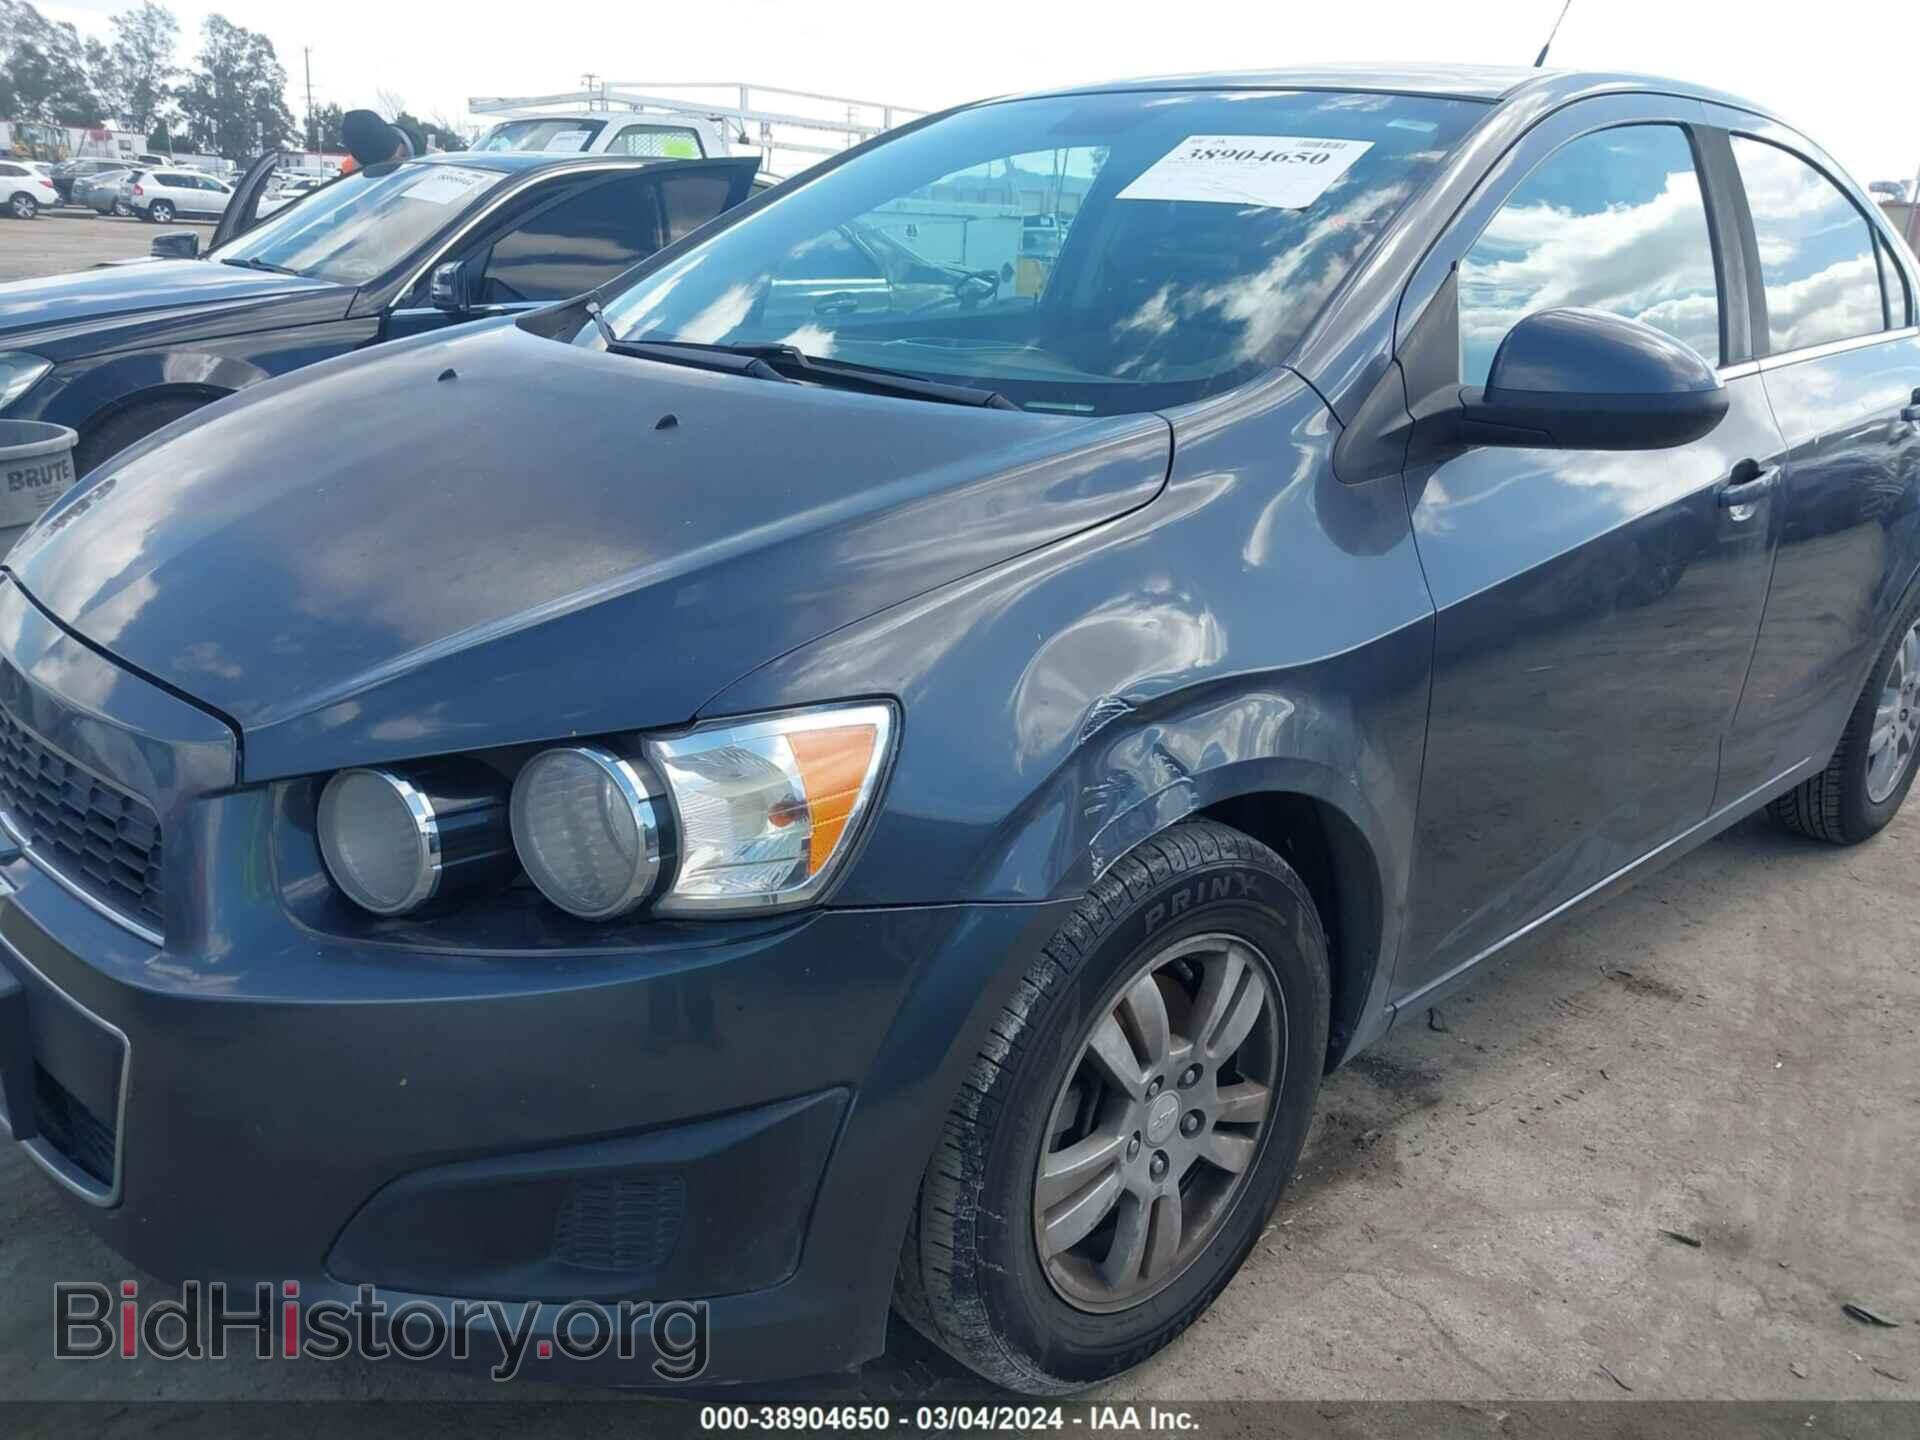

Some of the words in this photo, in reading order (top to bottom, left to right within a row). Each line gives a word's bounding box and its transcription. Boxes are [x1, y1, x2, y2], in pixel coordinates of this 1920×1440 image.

[1178, 146, 1332, 166] 38904650
[8, 459, 72, 492] BRUTE
[1145, 870, 1260, 936] PRINX
